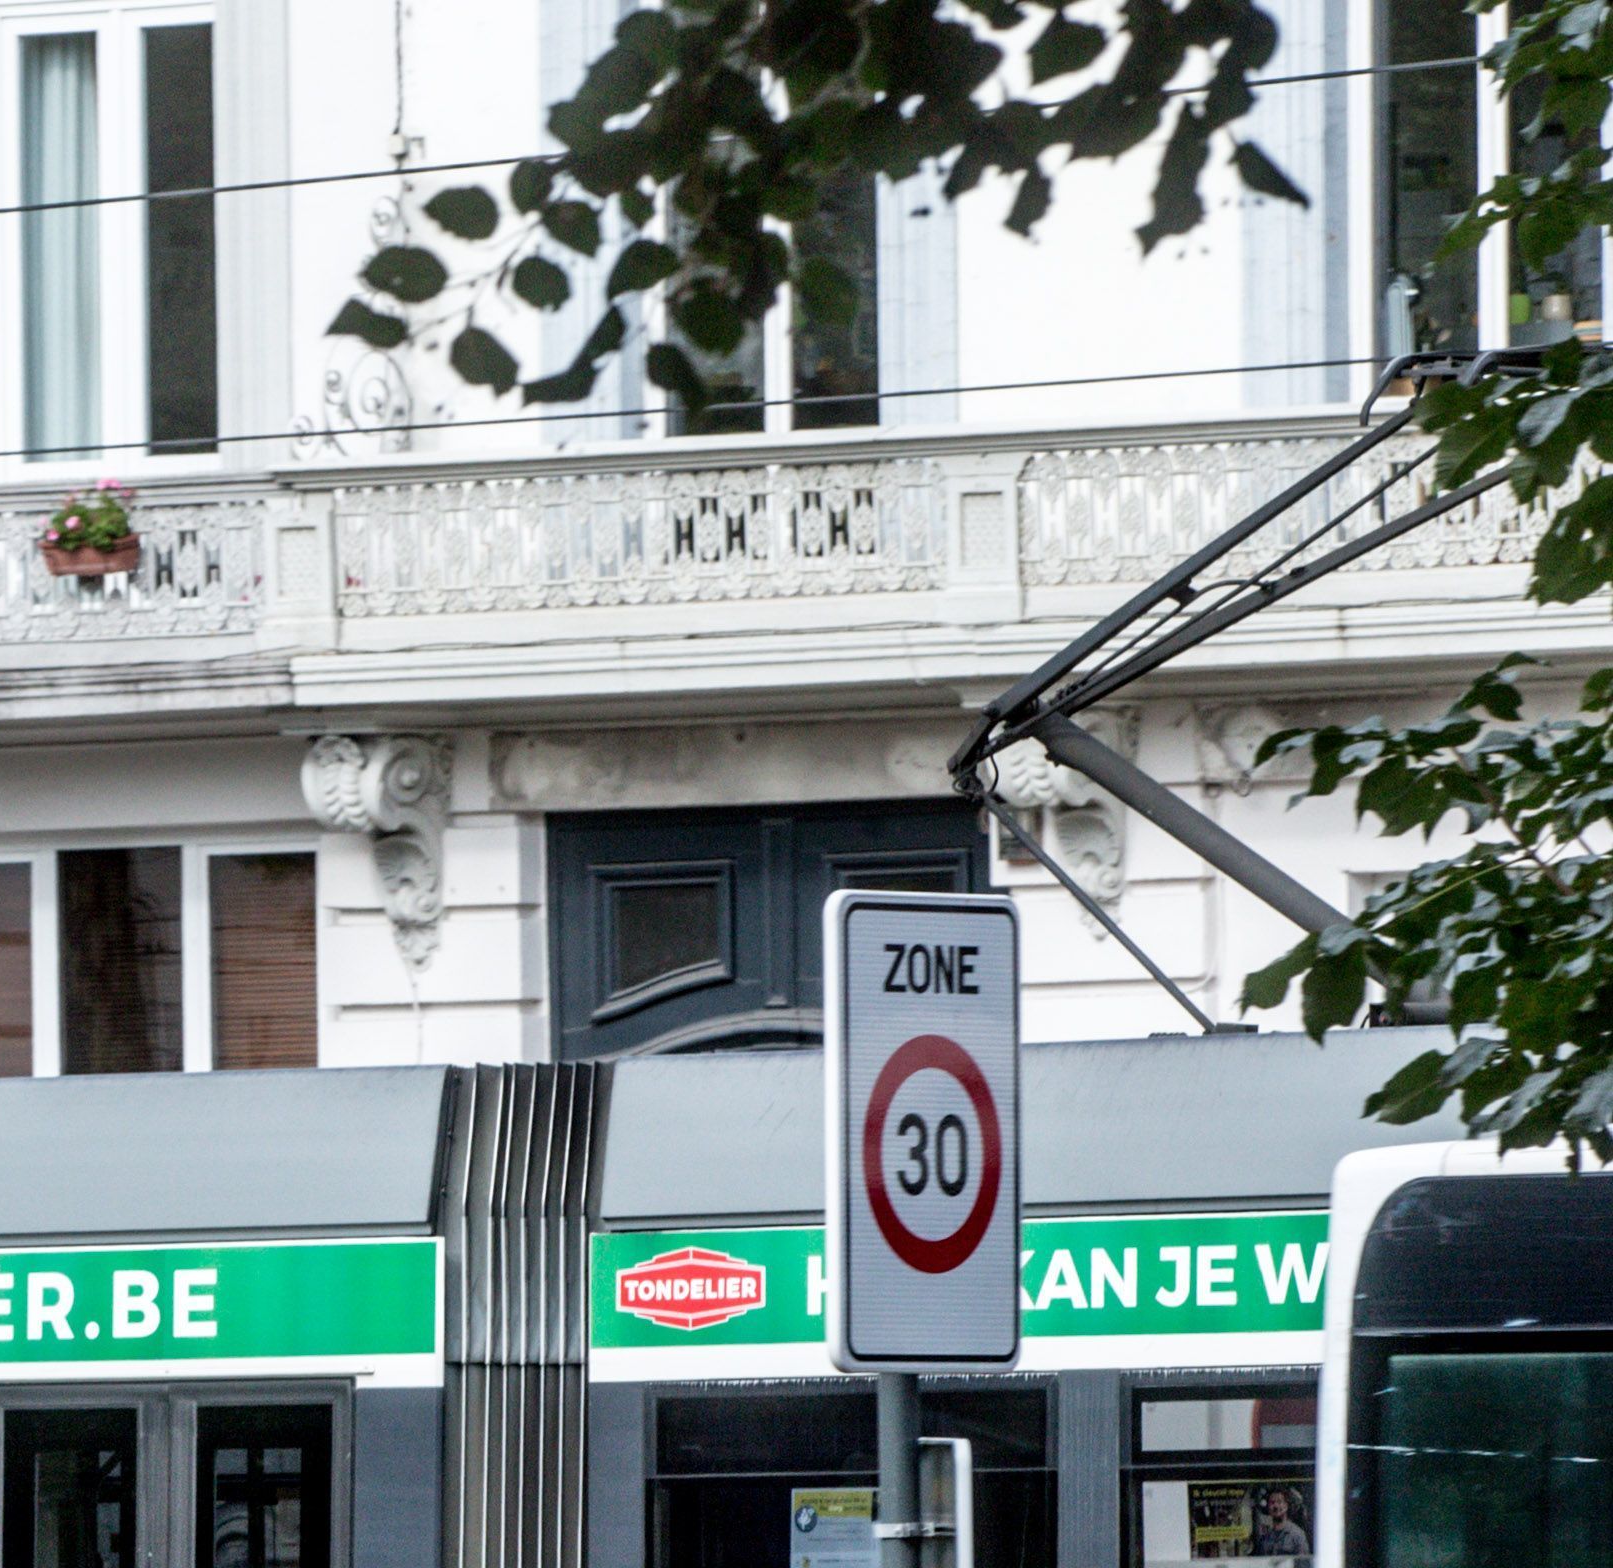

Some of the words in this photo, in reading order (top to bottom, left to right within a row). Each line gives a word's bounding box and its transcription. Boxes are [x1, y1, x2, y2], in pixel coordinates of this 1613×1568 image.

[883, 943, 980, 995] ZONE
[896, 1112, 969, 1197] 30
[624, 1276, 757, 1302] TONDELIER
[1154, 1245, 1238, 1308] JE
